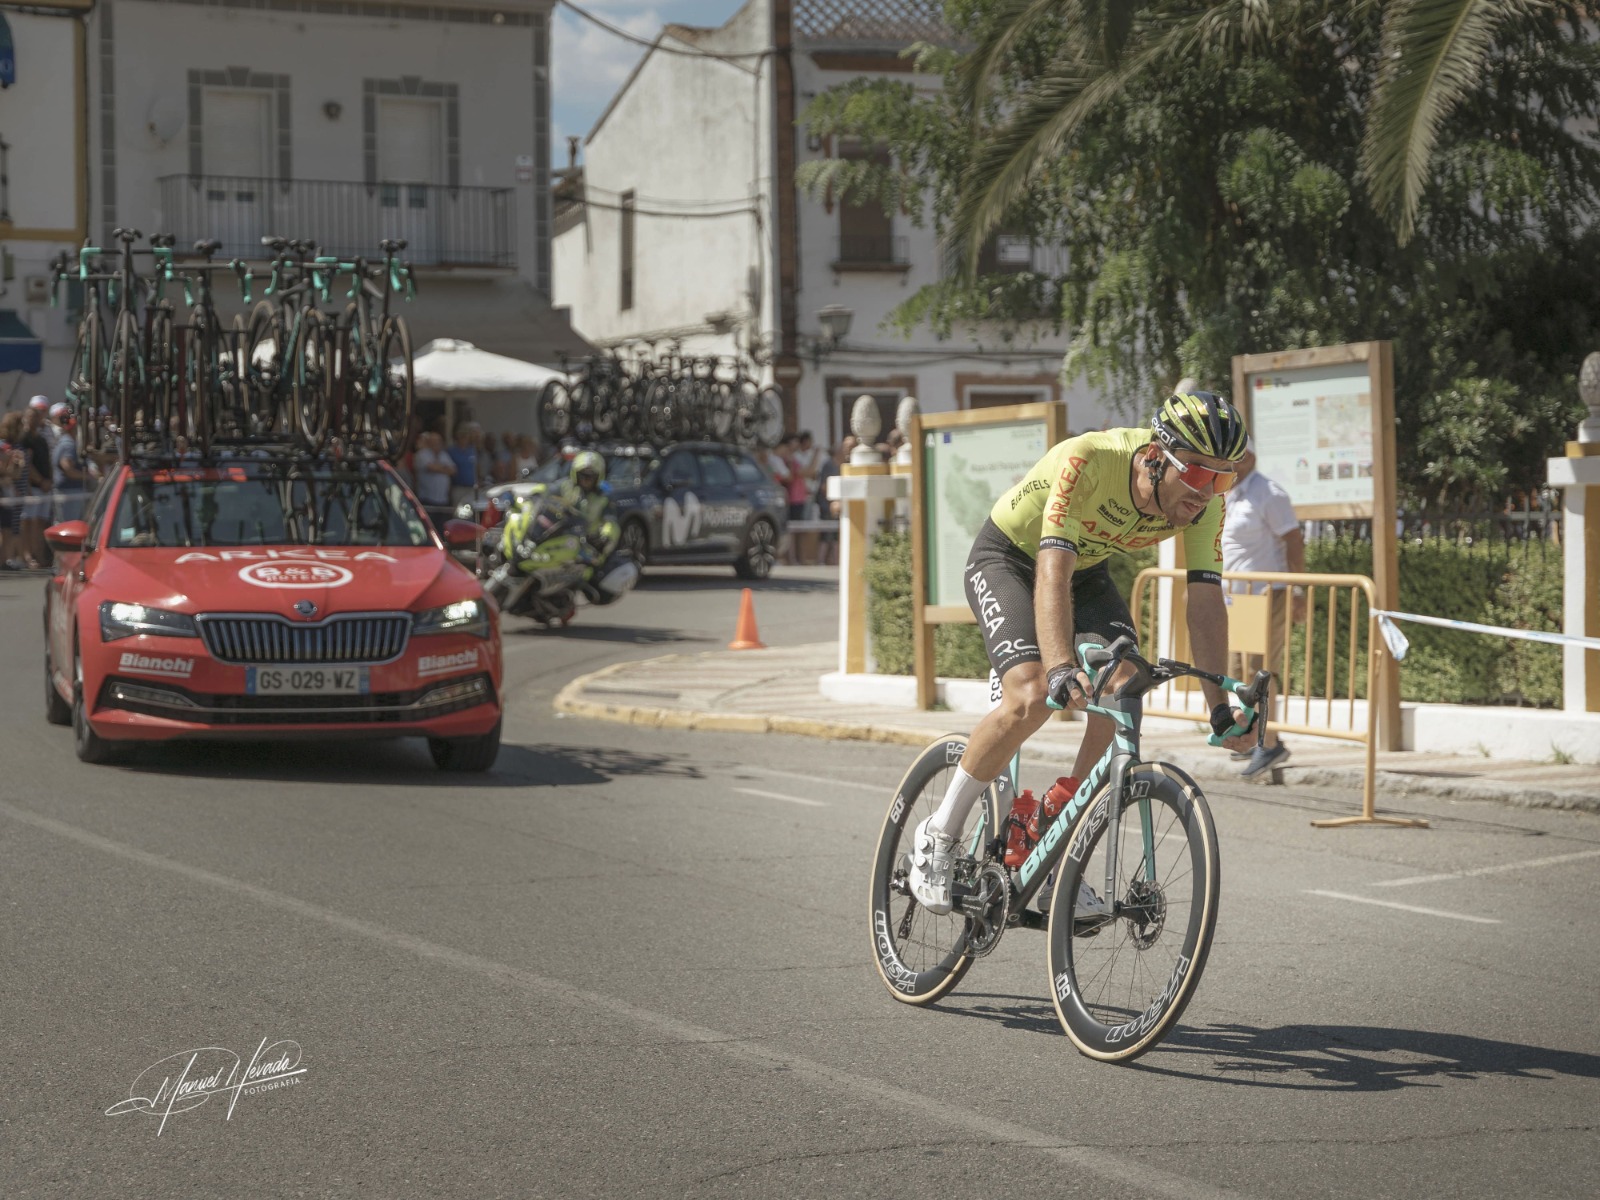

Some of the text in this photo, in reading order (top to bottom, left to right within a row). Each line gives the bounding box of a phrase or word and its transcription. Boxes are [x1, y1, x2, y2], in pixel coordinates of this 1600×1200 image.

[1022, 479, 1051, 497] HOTELS
[1047, 456, 1089, 529] ARKEA
[1099, 503, 1127, 526] Bianchi
[175, 549, 399, 564] ARKEA
[256, 567, 337, 578] B&B
[969, 571, 1006, 640] ARKEA
[119, 653, 195, 675] Bianchi
[418, 648, 479, 671] Bianchi
[1020, 741, 1112, 888] Bianchi
